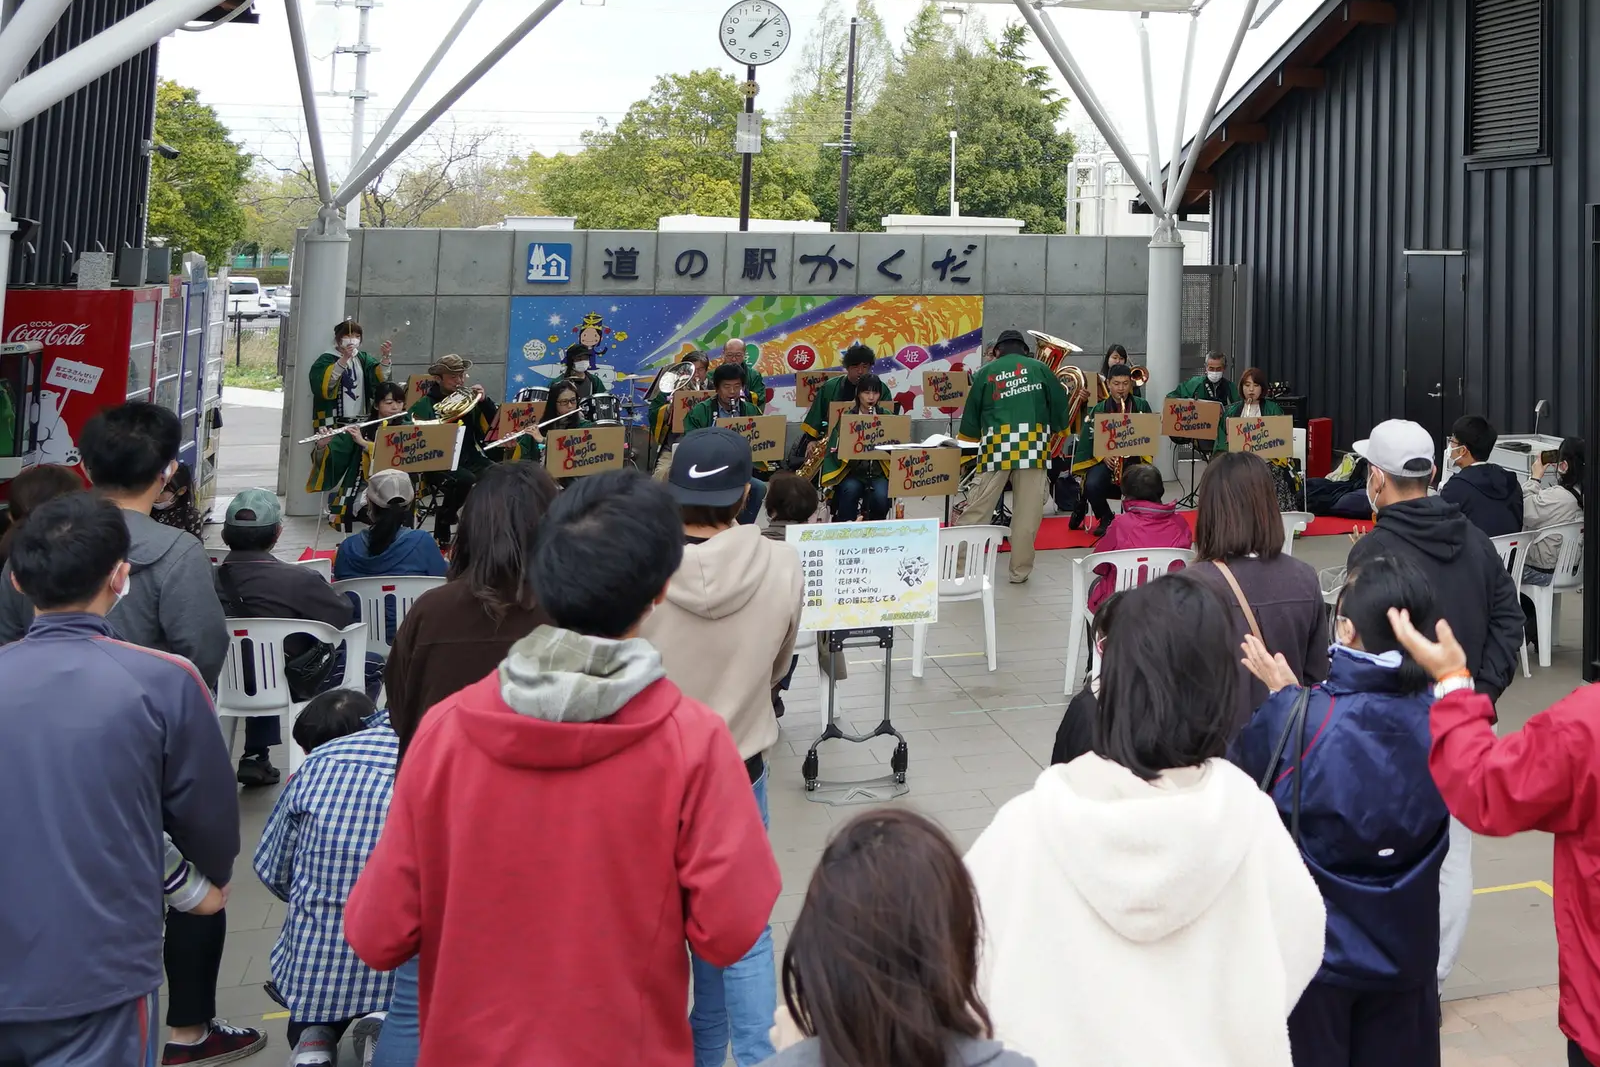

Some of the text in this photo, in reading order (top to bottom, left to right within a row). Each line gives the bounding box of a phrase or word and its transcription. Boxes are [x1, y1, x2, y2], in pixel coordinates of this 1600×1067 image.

[602, 244, 977, 284] 道の駅かくだ
[7, 323, 91, 345] Coca-Cola
[794, 349, 809, 364] 梅
[904, 350, 919, 363] 姫
[988, 363, 1028, 382] Kakuda
[992, 383, 1042, 400] Orchestra
[995, 376, 1028, 390] Magic
[1169, 401, 1195, 415] Kakuda
[849, 416, 881, 434] Kakuda
[1101, 415, 1131, 433] Kakuda
[1174, 421, 1211, 431] Orchestra
[1177, 411, 1198, 425] Magic
[1236, 418, 1265, 435] Kakuda
[385, 426, 423, 447] Kakuda
[557, 429, 592, 451] Kakuda
[857, 428, 884, 443] Magic
[1110, 426, 1134, 440] Magic
[1244, 428, 1269, 444] Magic
[395, 438, 426, 456] Magic
[567, 442, 596, 460] Magic
[1107, 437, 1150, 451] Orchestra
[391, 449, 443, 467] Orchestra
[563, 451, 614, 470] Orchestra
[898, 450, 930, 471] Kakuda
[906, 462, 933, 479] Magic
[904, 474, 949, 490] Orchestra
